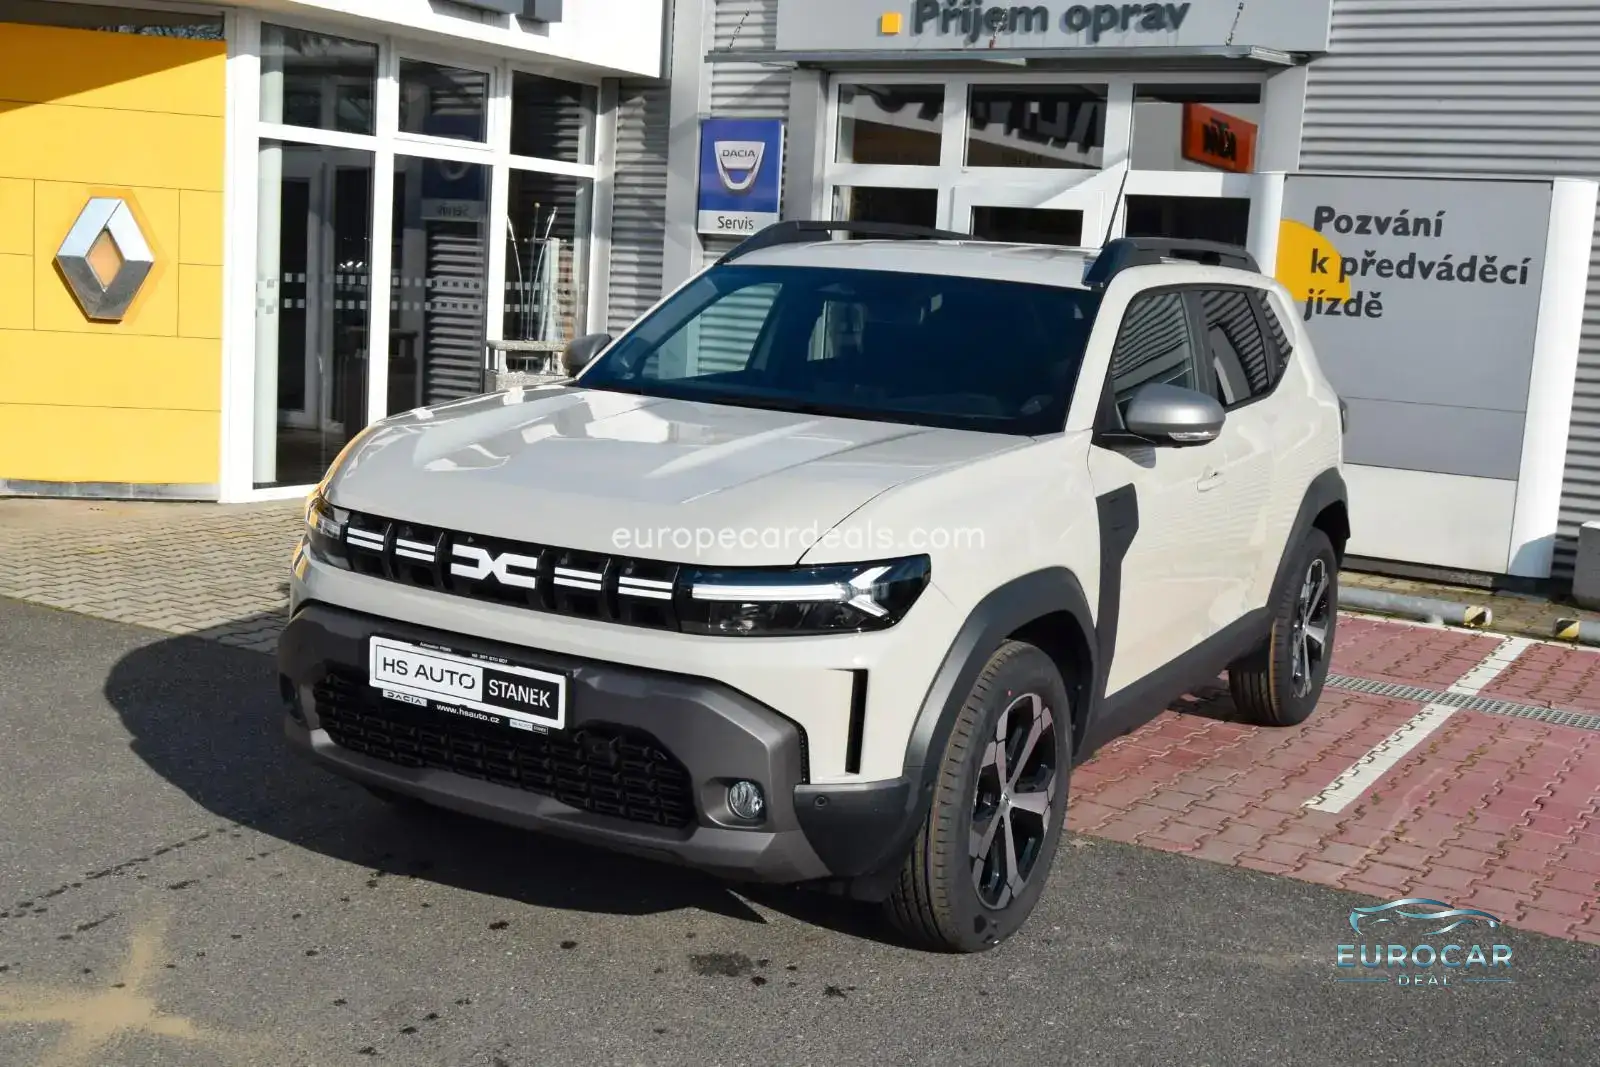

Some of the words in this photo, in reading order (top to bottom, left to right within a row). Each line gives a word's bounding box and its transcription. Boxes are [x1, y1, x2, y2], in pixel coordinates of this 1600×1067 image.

[1064, 2, 1191, 43] oprav
[722, 149, 756, 158] DACIA
[717, 215, 754, 230] Servis
[1313, 205, 1446, 237] Pozvání
[1310, 248, 1330, 275] k
[1338, 250, 1532, 285] předváděcí
[1303, 288, 1383, 321] jízdě
[382, 656, 409, 676] HS
[414, 663, 476, 690] AUTO
[488, 679, 550, 709] STANEK
[436, 703, 500, 724] www.hsauto.cz
